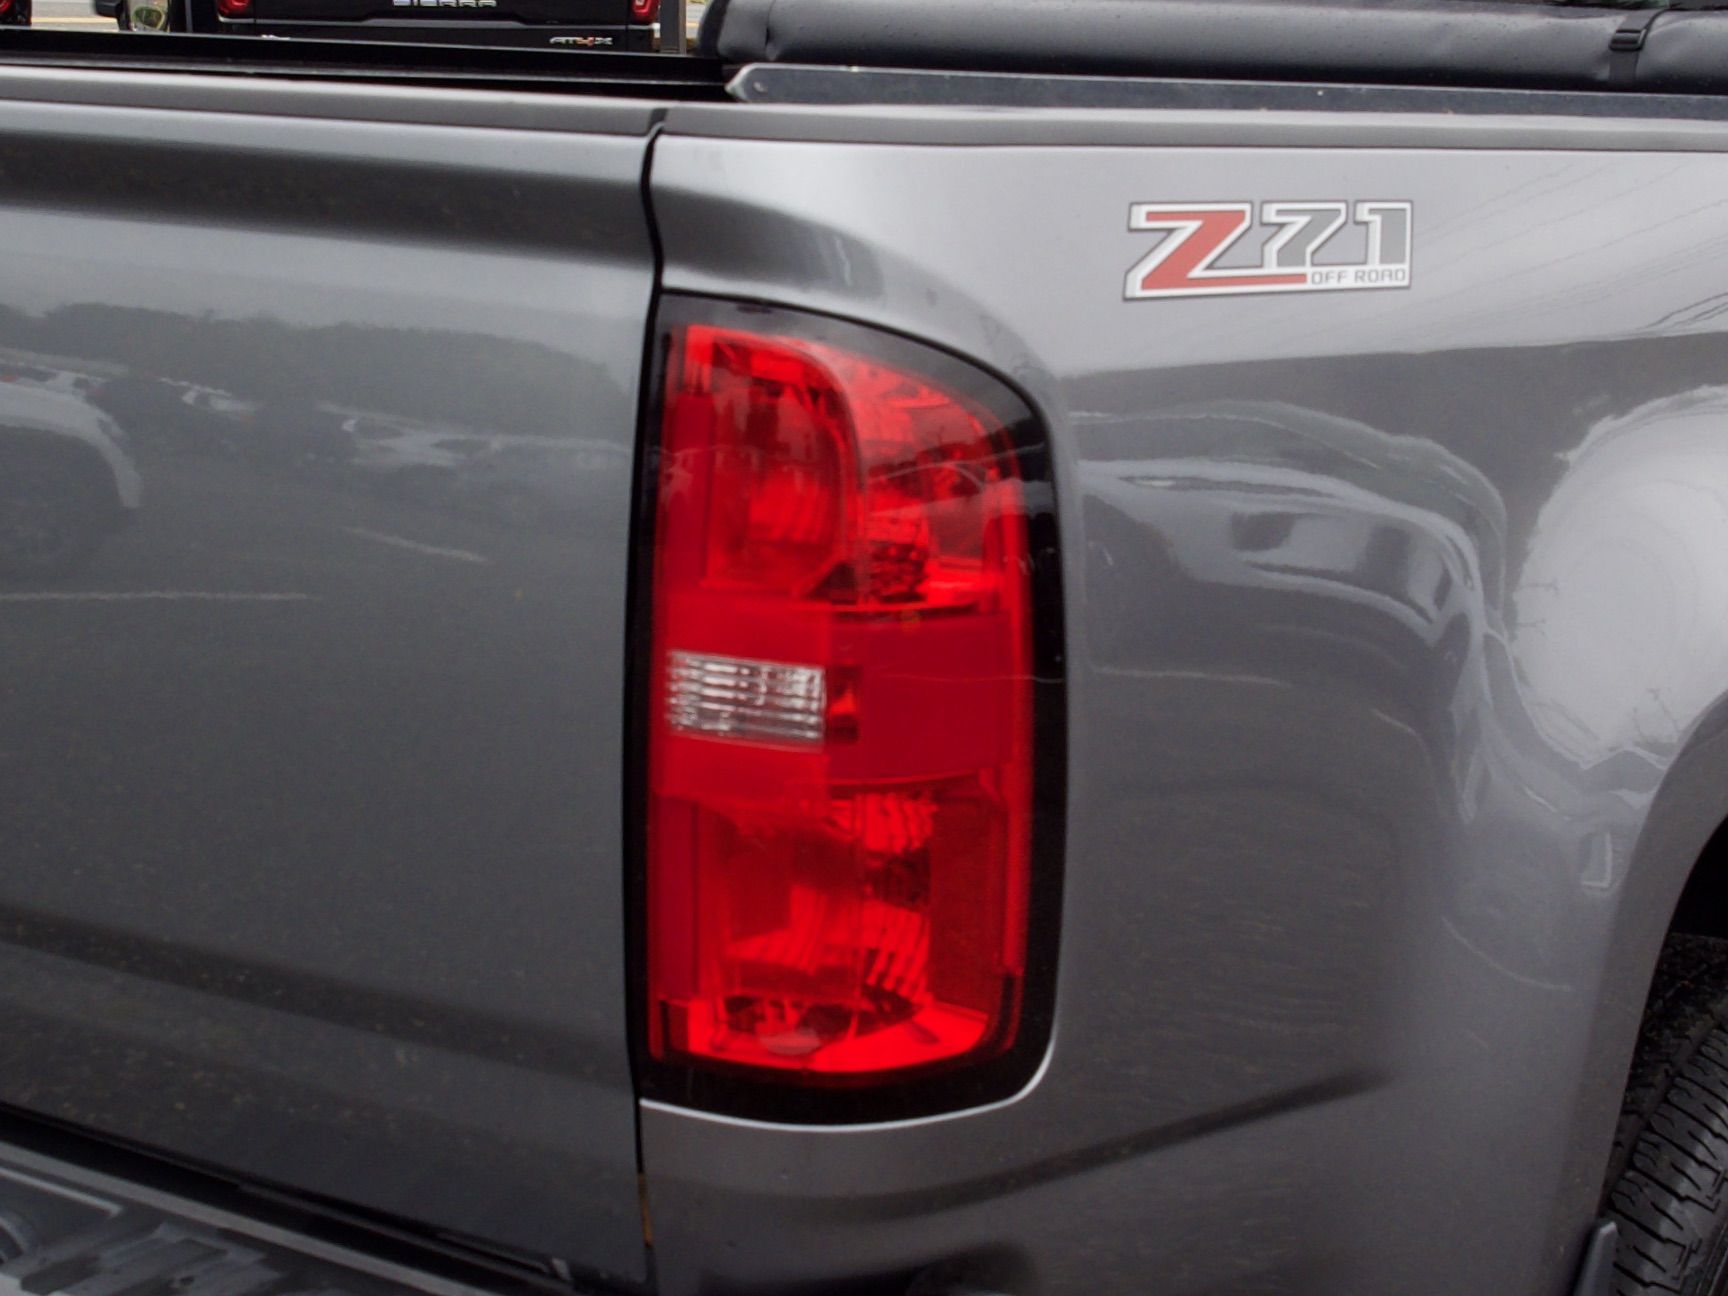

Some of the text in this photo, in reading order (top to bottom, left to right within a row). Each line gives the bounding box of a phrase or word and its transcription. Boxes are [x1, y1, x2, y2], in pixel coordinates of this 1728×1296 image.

[1123, 201, 1413, 301] Z71
[1310, 268, 1407, 286] OFF ROAD
